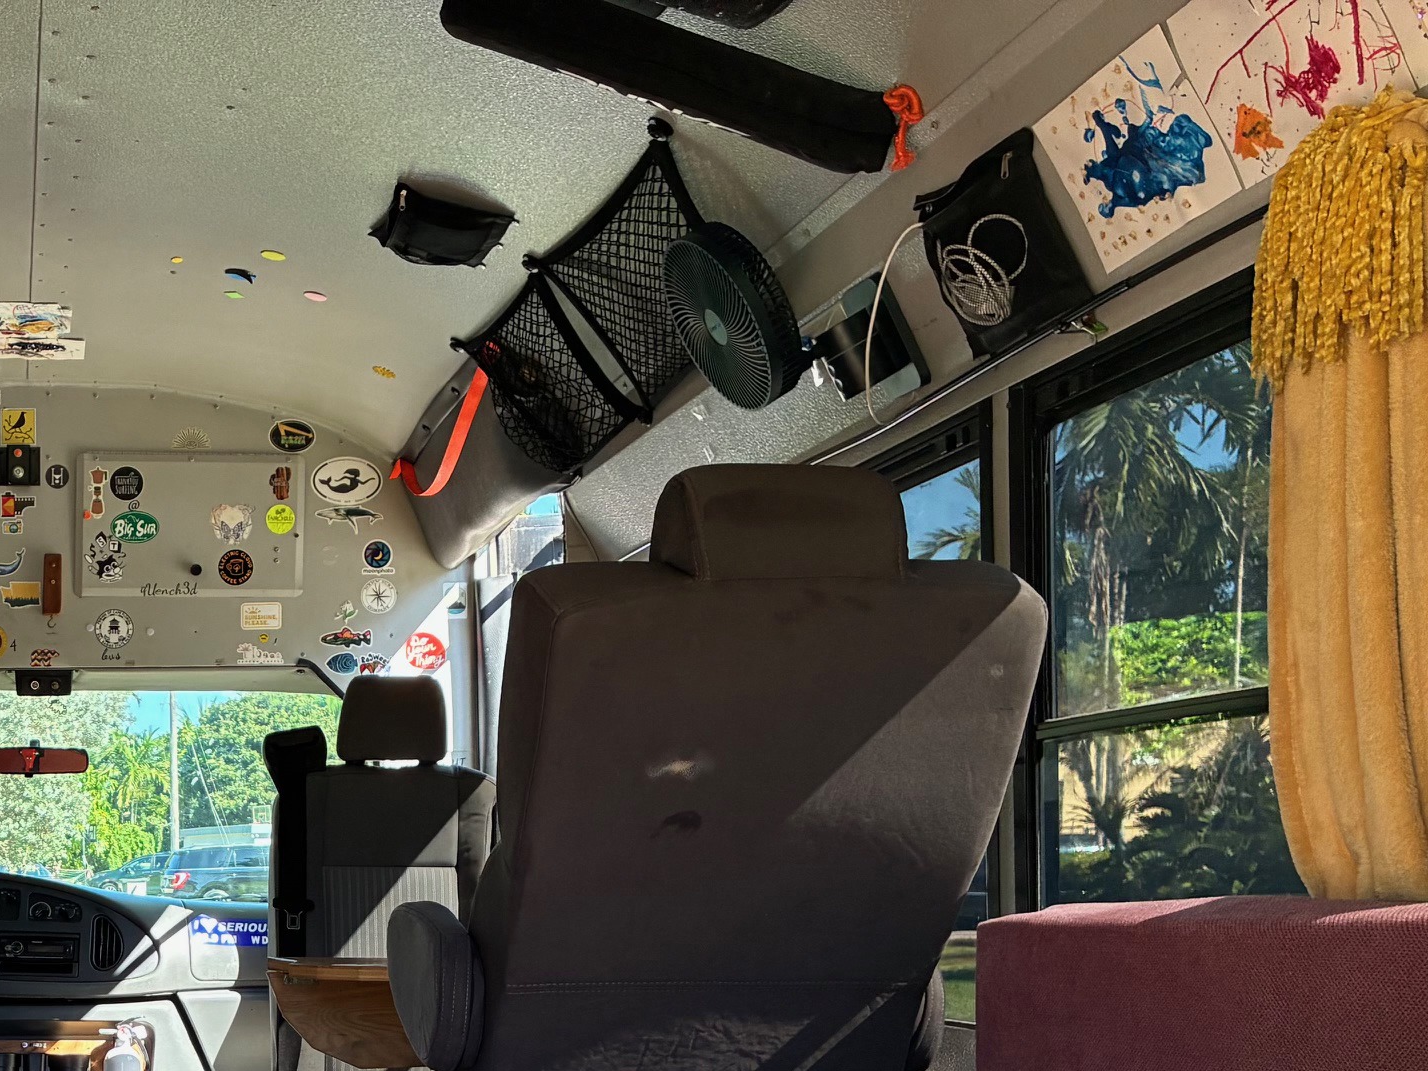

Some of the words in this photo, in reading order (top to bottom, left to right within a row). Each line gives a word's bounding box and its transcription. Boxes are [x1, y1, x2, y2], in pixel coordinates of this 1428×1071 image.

[115, 485, 139, 495] SURFING
[128, 500, 140, 511] @
[219, 551, 239, 569] ELECTRIC
[220, 570, 237, 584] COFFEE
[238, 569, 252, 583] STAND
[410, 635, 429, 646] Do
[407, 643, 436, 659] Your
[412, 653, 444, 668] Thing
[217, 921, 269, 933] SERIOU
